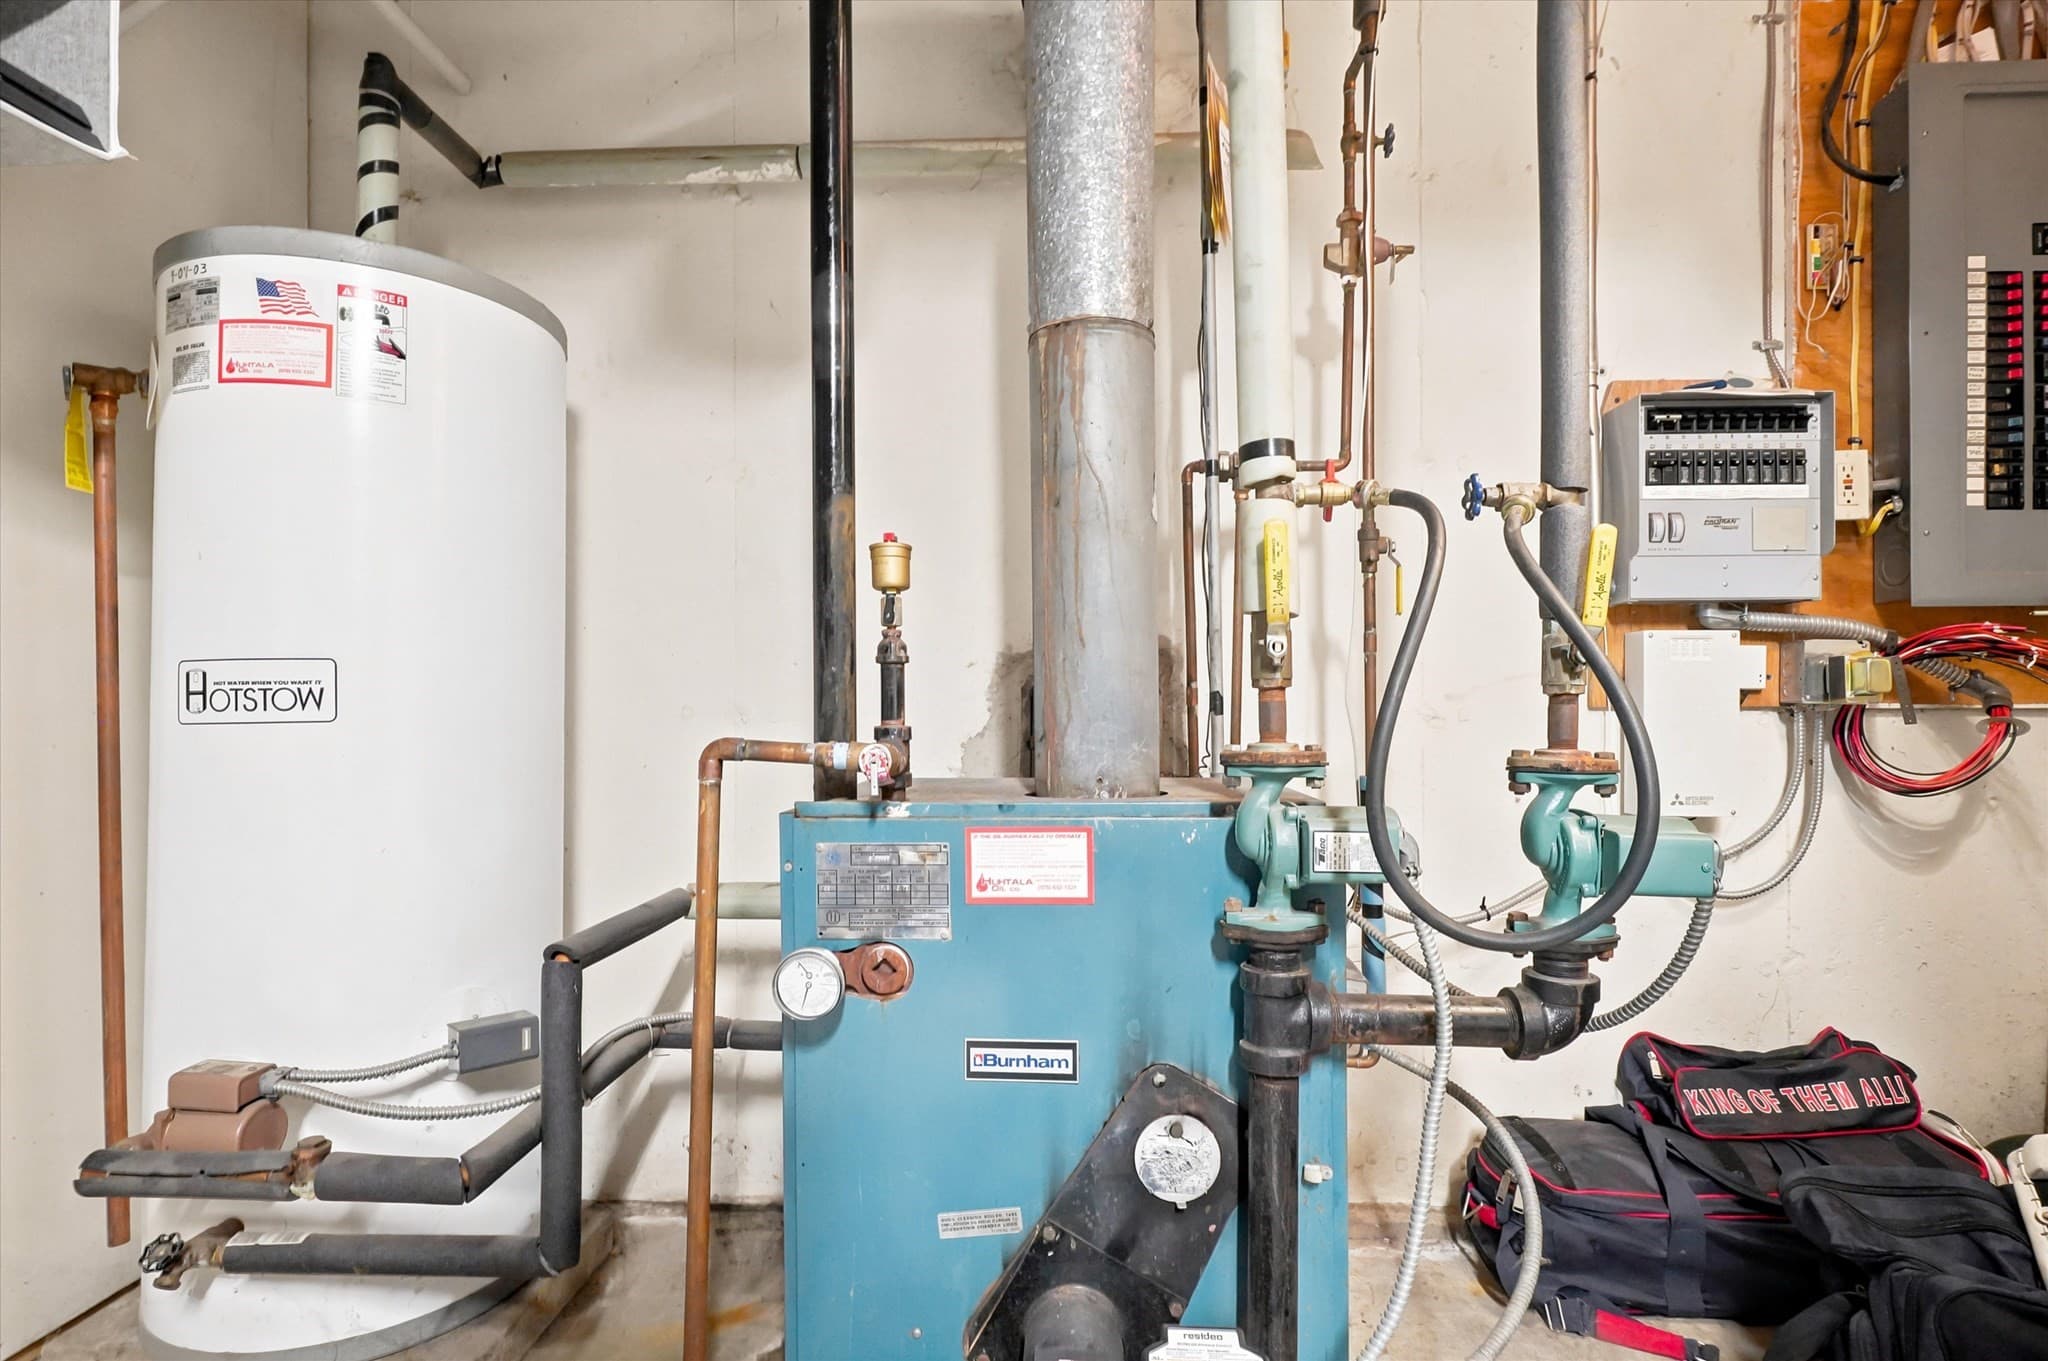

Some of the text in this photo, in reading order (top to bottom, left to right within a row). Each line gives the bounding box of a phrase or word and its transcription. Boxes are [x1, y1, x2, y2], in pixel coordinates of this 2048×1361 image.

[982, 876, 1033, 886] HUHTALA
[983, 1053, 1069, 1069] Burnham
[1683, 1075, 1911, 1116] KING OF THEM ALL!
[1183, 1332, 1224, 1341] resideo
